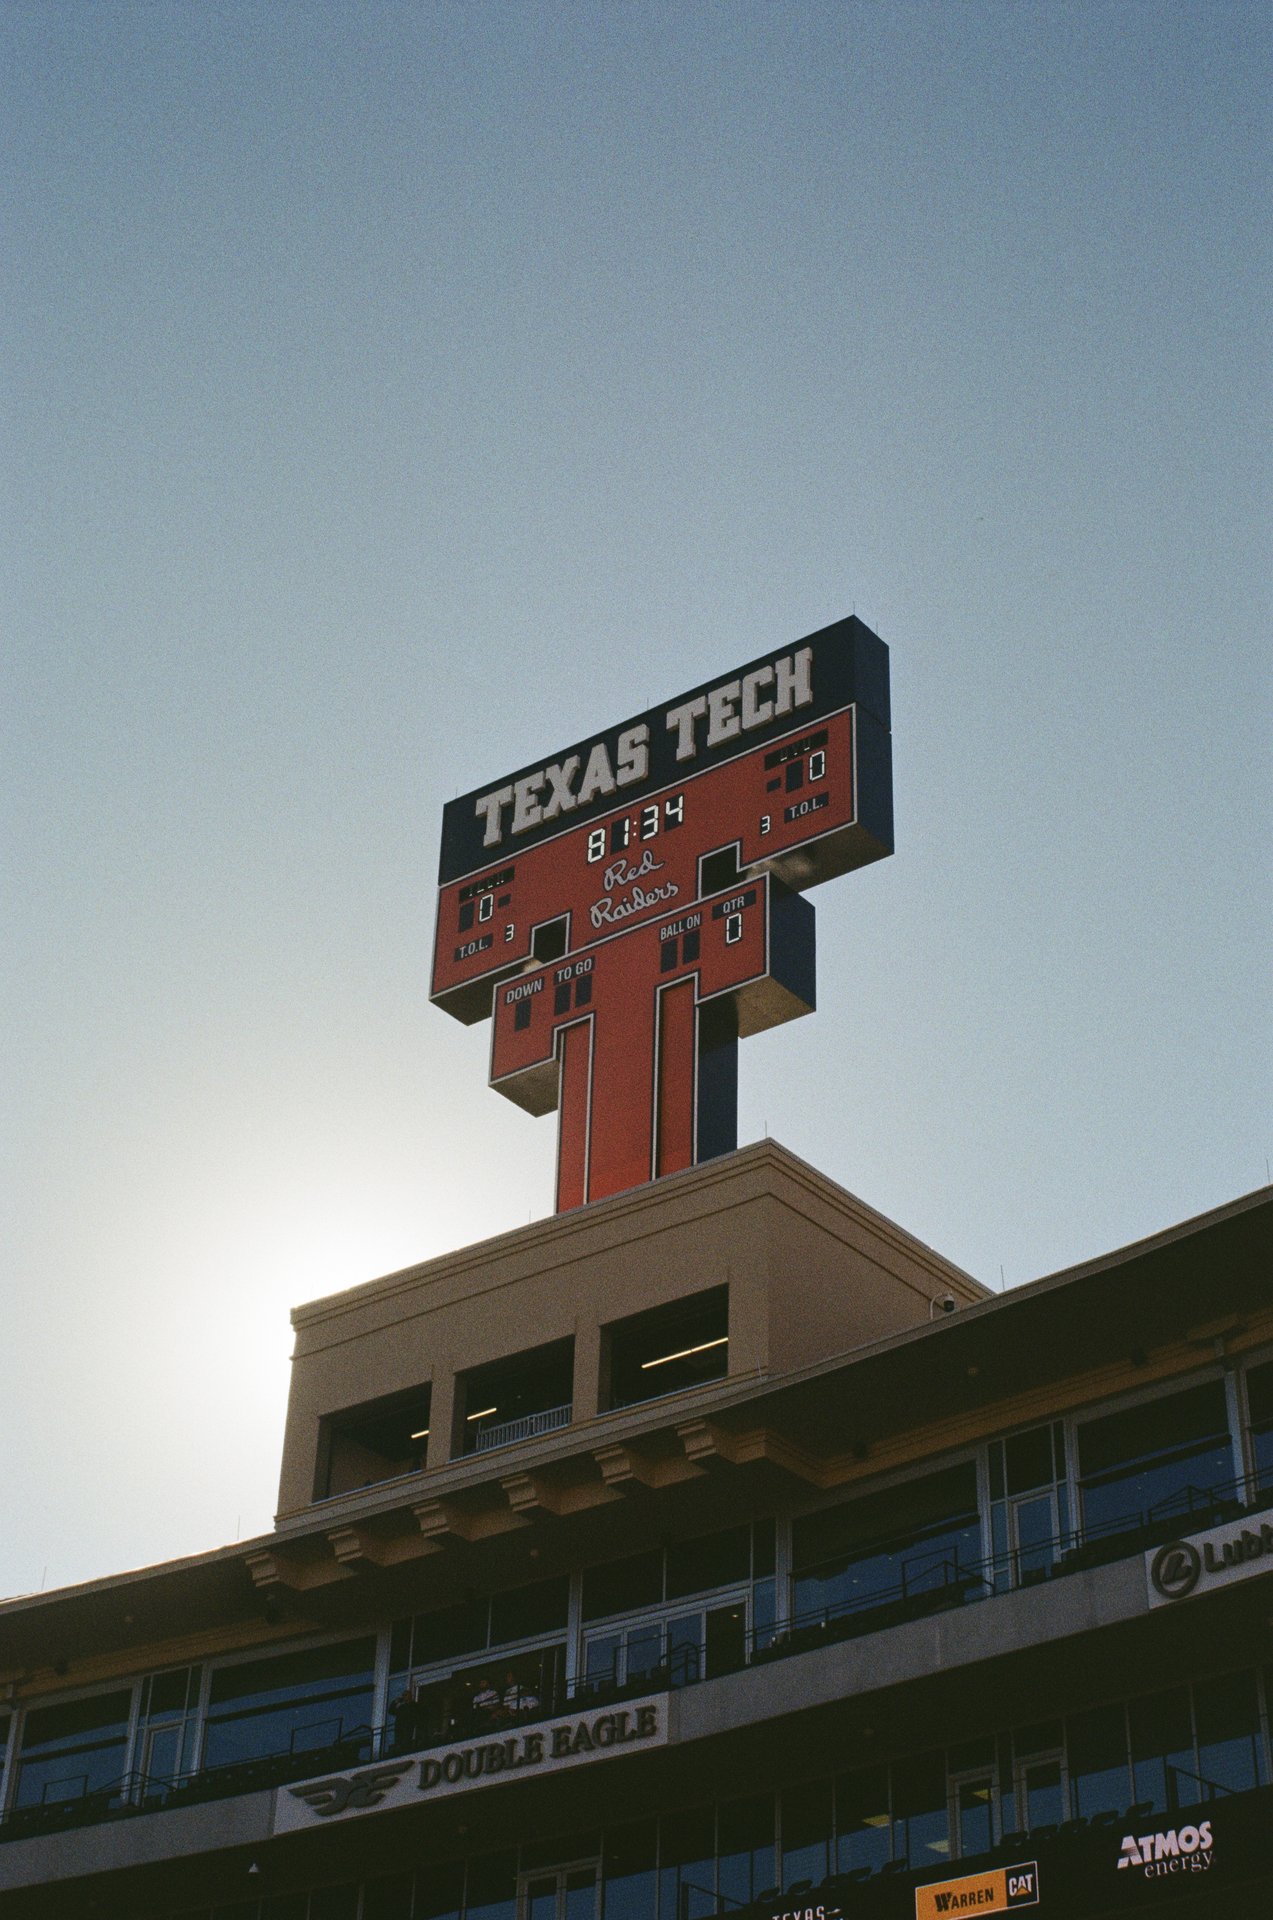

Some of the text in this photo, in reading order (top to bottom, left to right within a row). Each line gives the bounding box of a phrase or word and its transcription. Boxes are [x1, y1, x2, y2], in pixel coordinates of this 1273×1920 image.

[475, 646, 813, 849] TEXAS TECH
[789, 798, 824, 819] T.O.L.
[761, 815, 771, 835] 3
[604, 850, 665, 891] Red
[590, 881, 679, 928] Raiders
[723, 896, 745, 913] QTR
[505, 924, 514, 942] 3
[661, 913, 701, 940] BALL ON
[726, 913, 741, 944] 0
[459, 939, 488, 959] T.O.L.
[557, 958, 593, 983] TO GO
[506, 978, 543, 1004] DOWN
[417, 1705, 657, 1790] DOUBLE EAGLE
[1117, 1820, 1213, 1869] ATMOS
[1144, 1850, 1212, 1878] energy
[934, 1873, 1033, 1912] WARREN CAT
